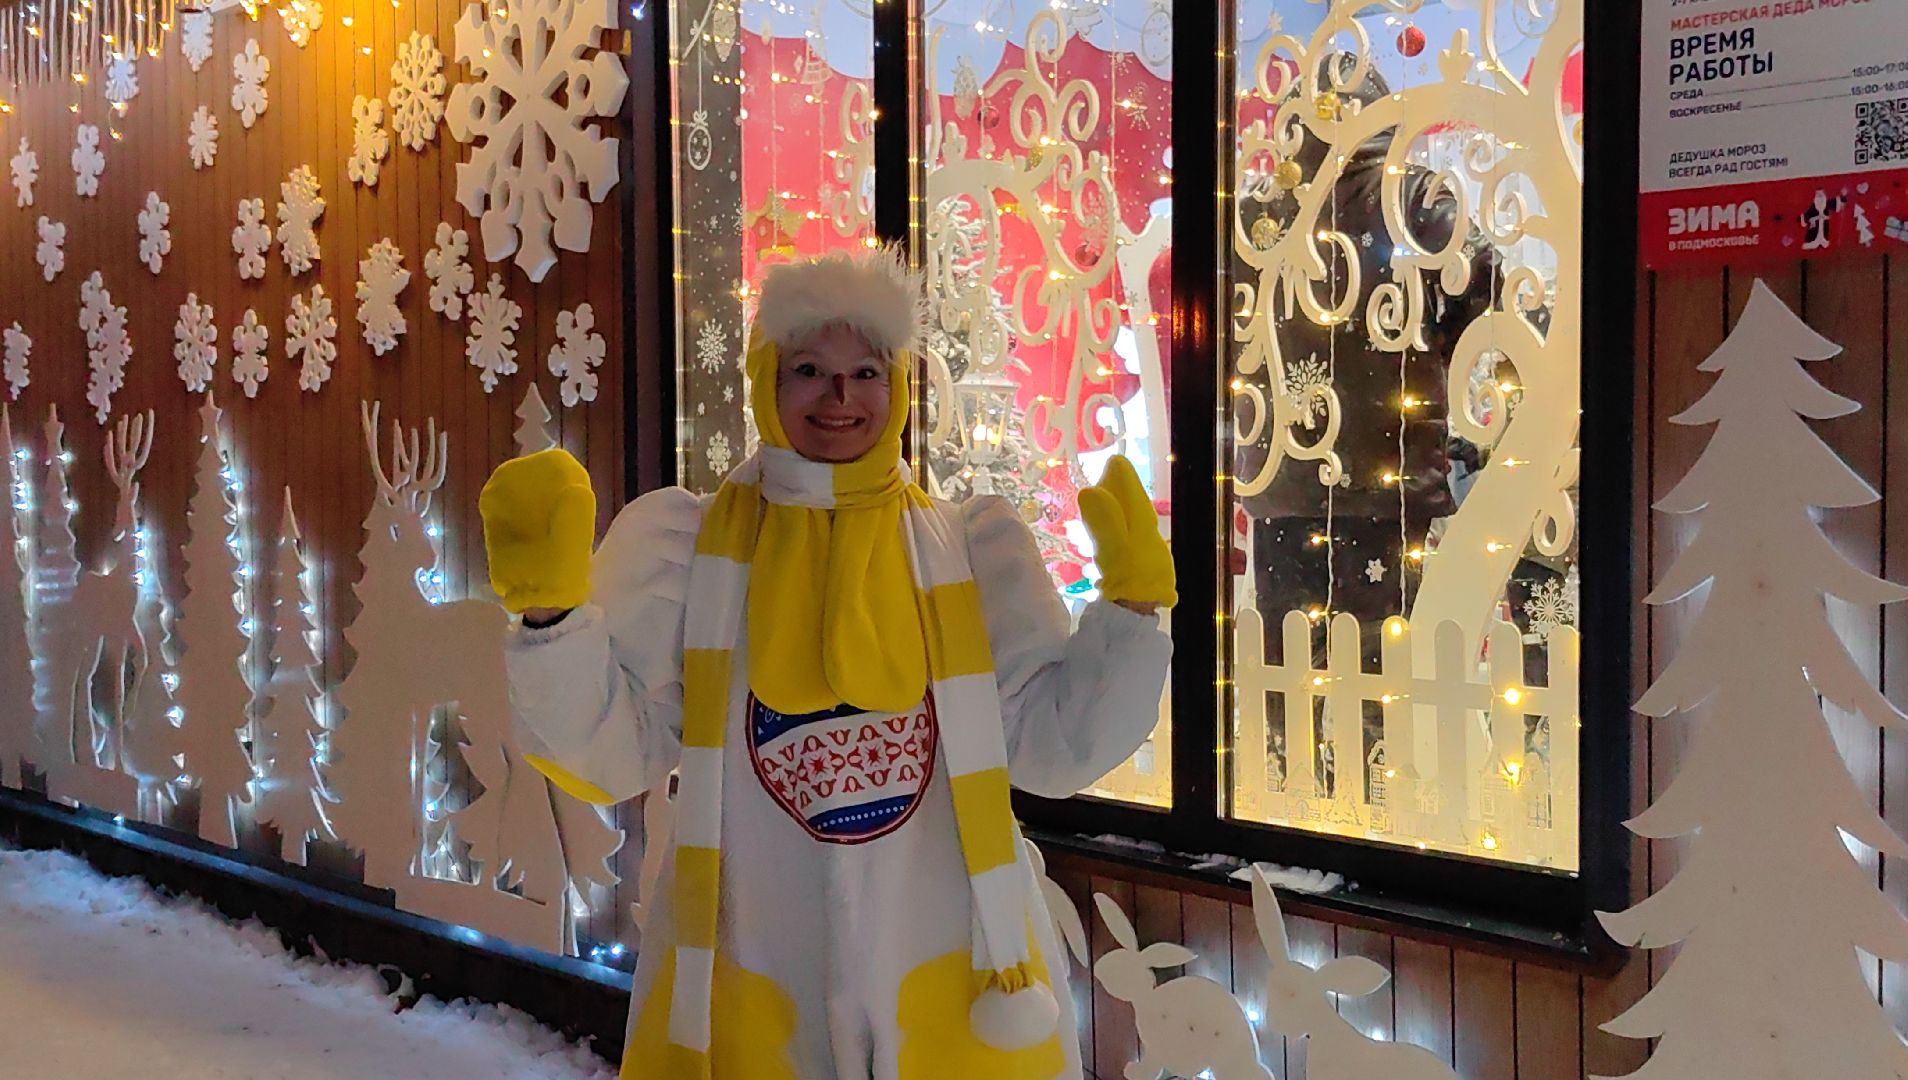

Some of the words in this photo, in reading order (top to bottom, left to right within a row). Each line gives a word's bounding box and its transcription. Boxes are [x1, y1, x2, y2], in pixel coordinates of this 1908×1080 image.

[1671, 9, 1768, 31] МАСТЕРСКАЯ
[1772, 0, 1814, 18] ДЕДА
[1670, 27, 1754, 59] ВРЕМЯ
[1669, 51, 1773, 85] РАБОТЫ
[1670, 88, 1703, 100] СРЕДА
[1669, 101, 1742, 118] ВОСКРЕСЕНЬЕ
[1669, 148, 1725, 164] ДЕДУШКА
[1727, 144, 1766, 157] МОРОЗ
[1669, 165, 1712, 178] ВСЕГДА
[1714, 162, 1738, 174] РАД
[1668, 199, 1760, 235] ЗИМА
[1677, 234, 1760, 252] ПОДМОСКОВЬЕ
